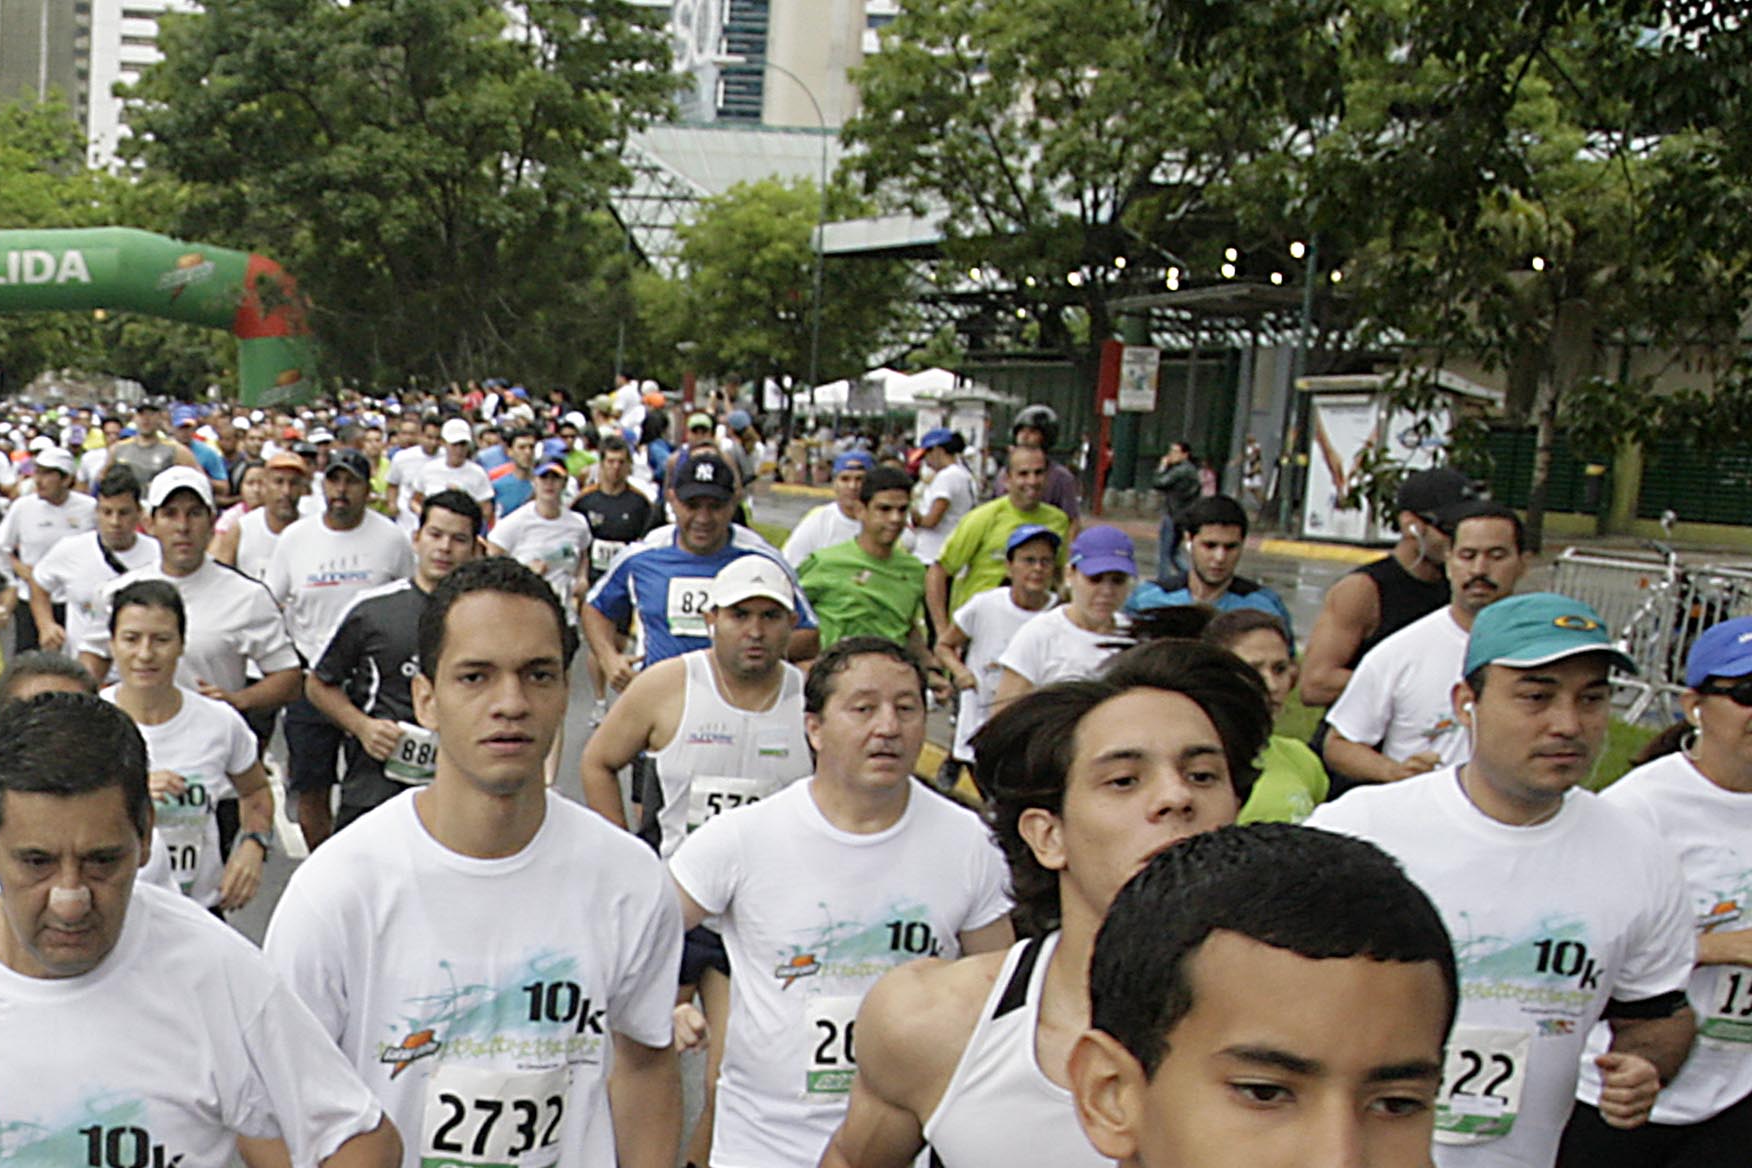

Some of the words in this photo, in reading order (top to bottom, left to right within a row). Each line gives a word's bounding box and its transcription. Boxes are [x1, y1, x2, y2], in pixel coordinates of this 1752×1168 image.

[1533, 939, 1604, 989] 10k
[523, 981, 606, 1035] 10k
[431, 1093, 564, 1157] 2732
